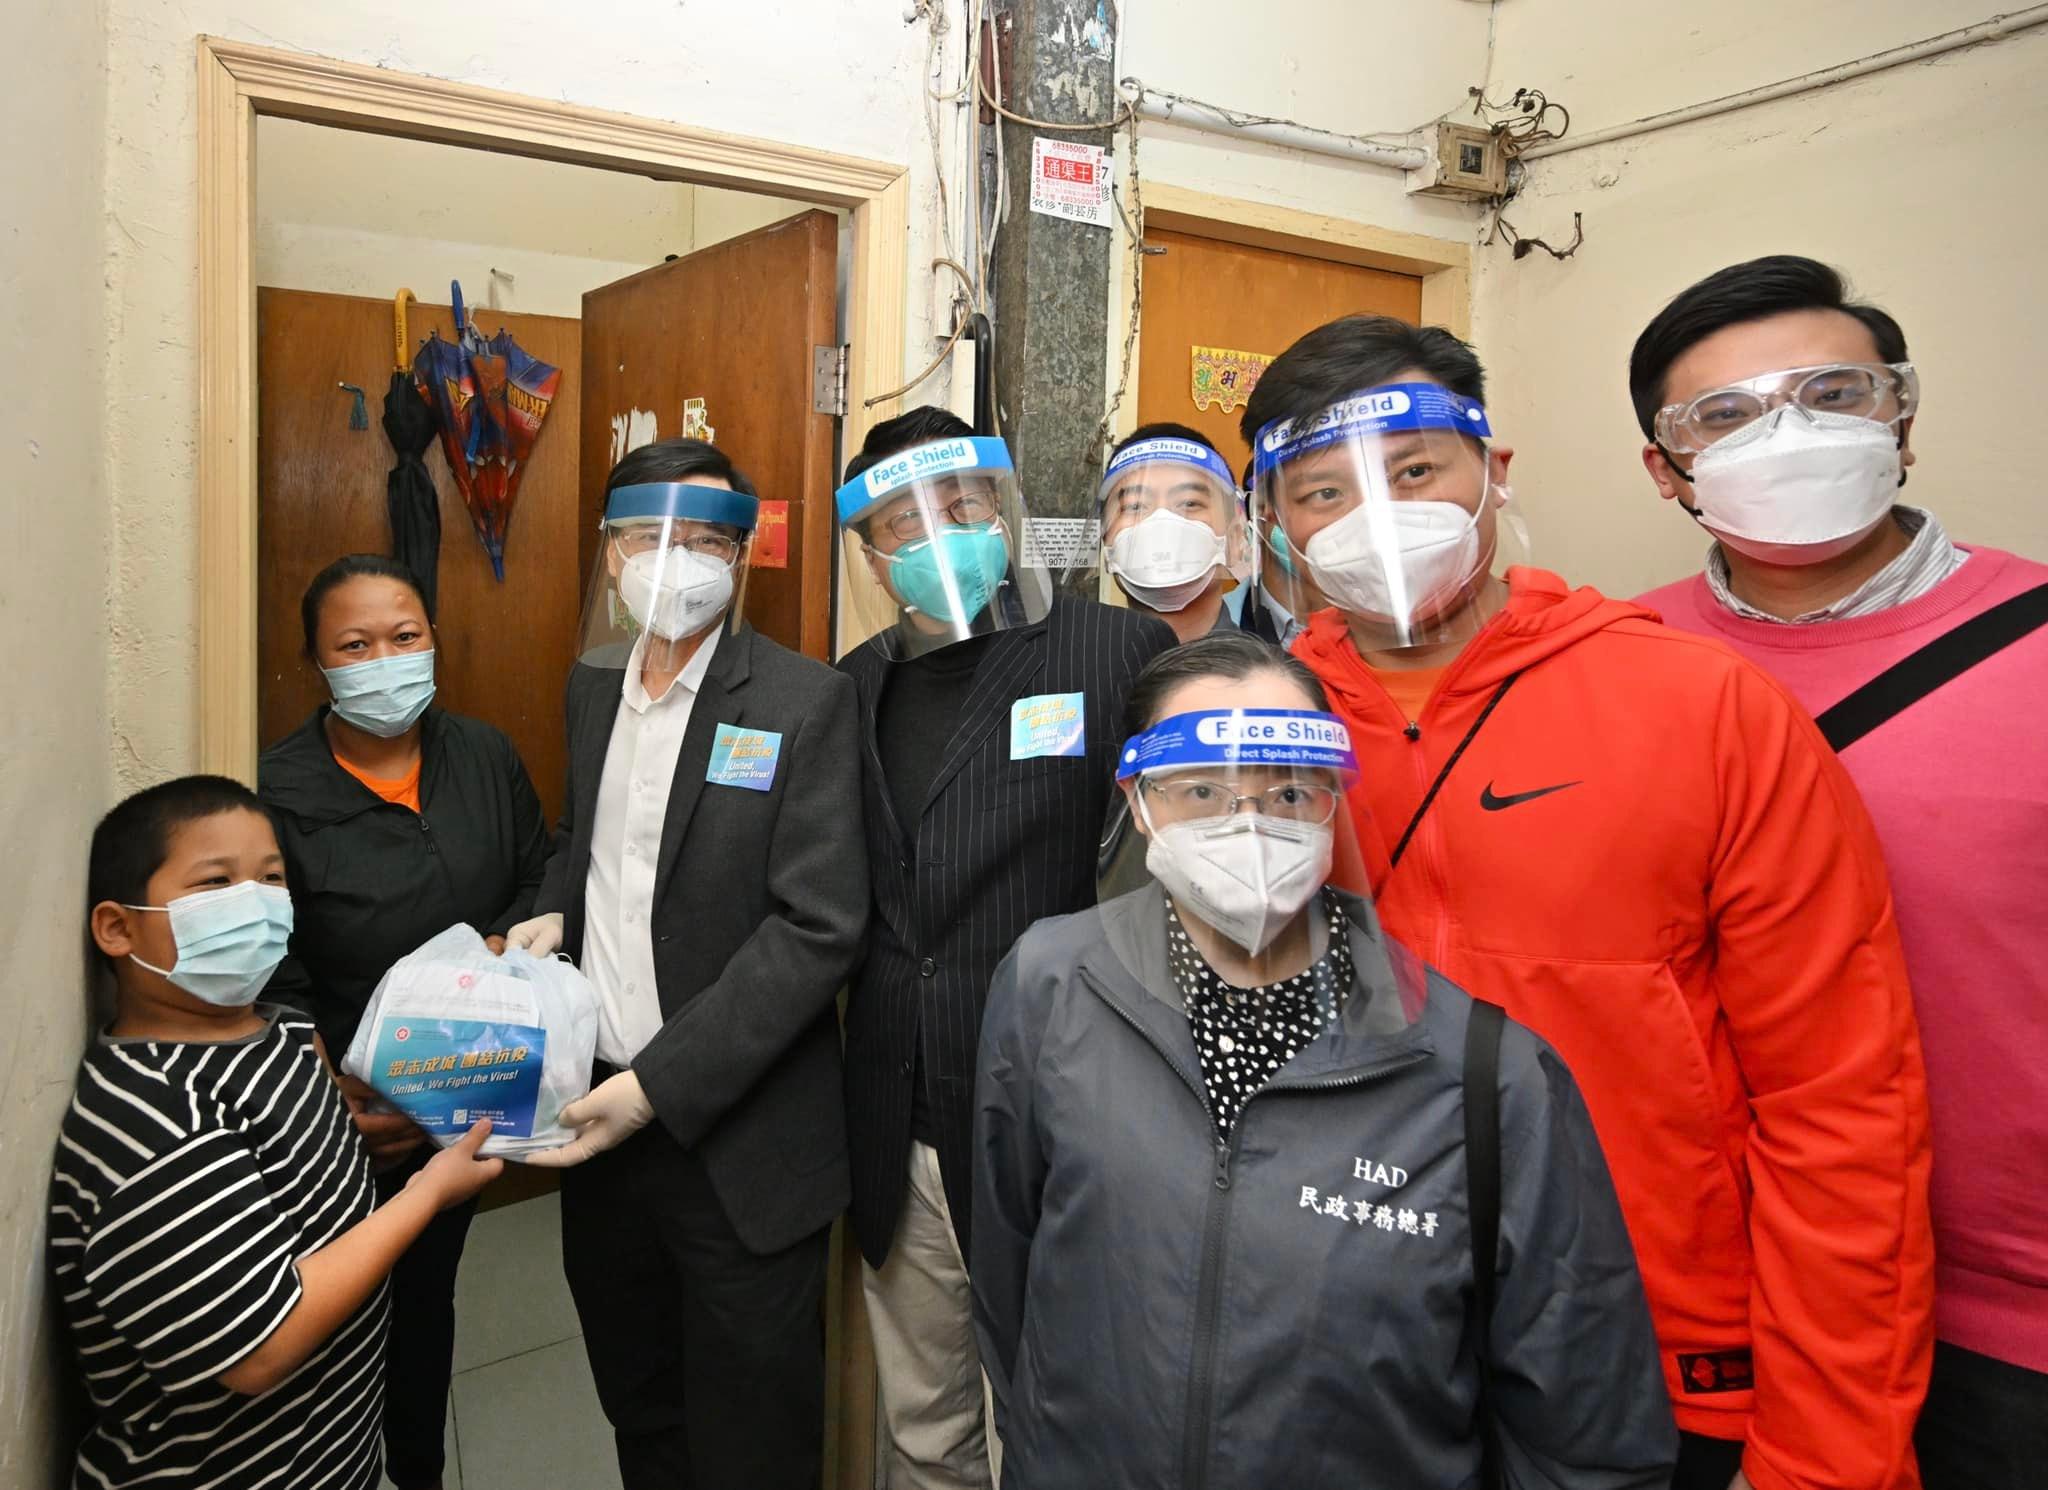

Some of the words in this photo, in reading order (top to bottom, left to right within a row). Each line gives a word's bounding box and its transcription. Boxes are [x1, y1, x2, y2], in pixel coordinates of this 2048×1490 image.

[1045, 158, 1092, 183] 通渠王
[1319, 396, 1393, 425] Shield
[1149, 441, 1198, 455] Shield
[873, 460, 908, 485] Face
[912, 442, 966, 467] Shield
[891, 471, 913, 488] splash
[914, 460, 954, 477] protection
[1048, 558, 1068, 566] 9077
[1286, 721, 1346, 745] Shield
[1224, 748, 1259, 759] Drect
[1262, 749, 1301, 761] Splash
[1302, 750, 1345, 763] Protection
[460, 1046, 529, 1069] 團結抗疫
[391, 1080, 426, 1095] United,
[428, 1078, 444, 1089] We
[446, 1075, 472, 1088] Fight
[472, 1072, 487, 1084] the
[490, 1069, 519, 1082] Virus!
[1353, 1157, 1408, 1188] HAD
[1299, 1185, 1440, 1239] 民政事務總署
